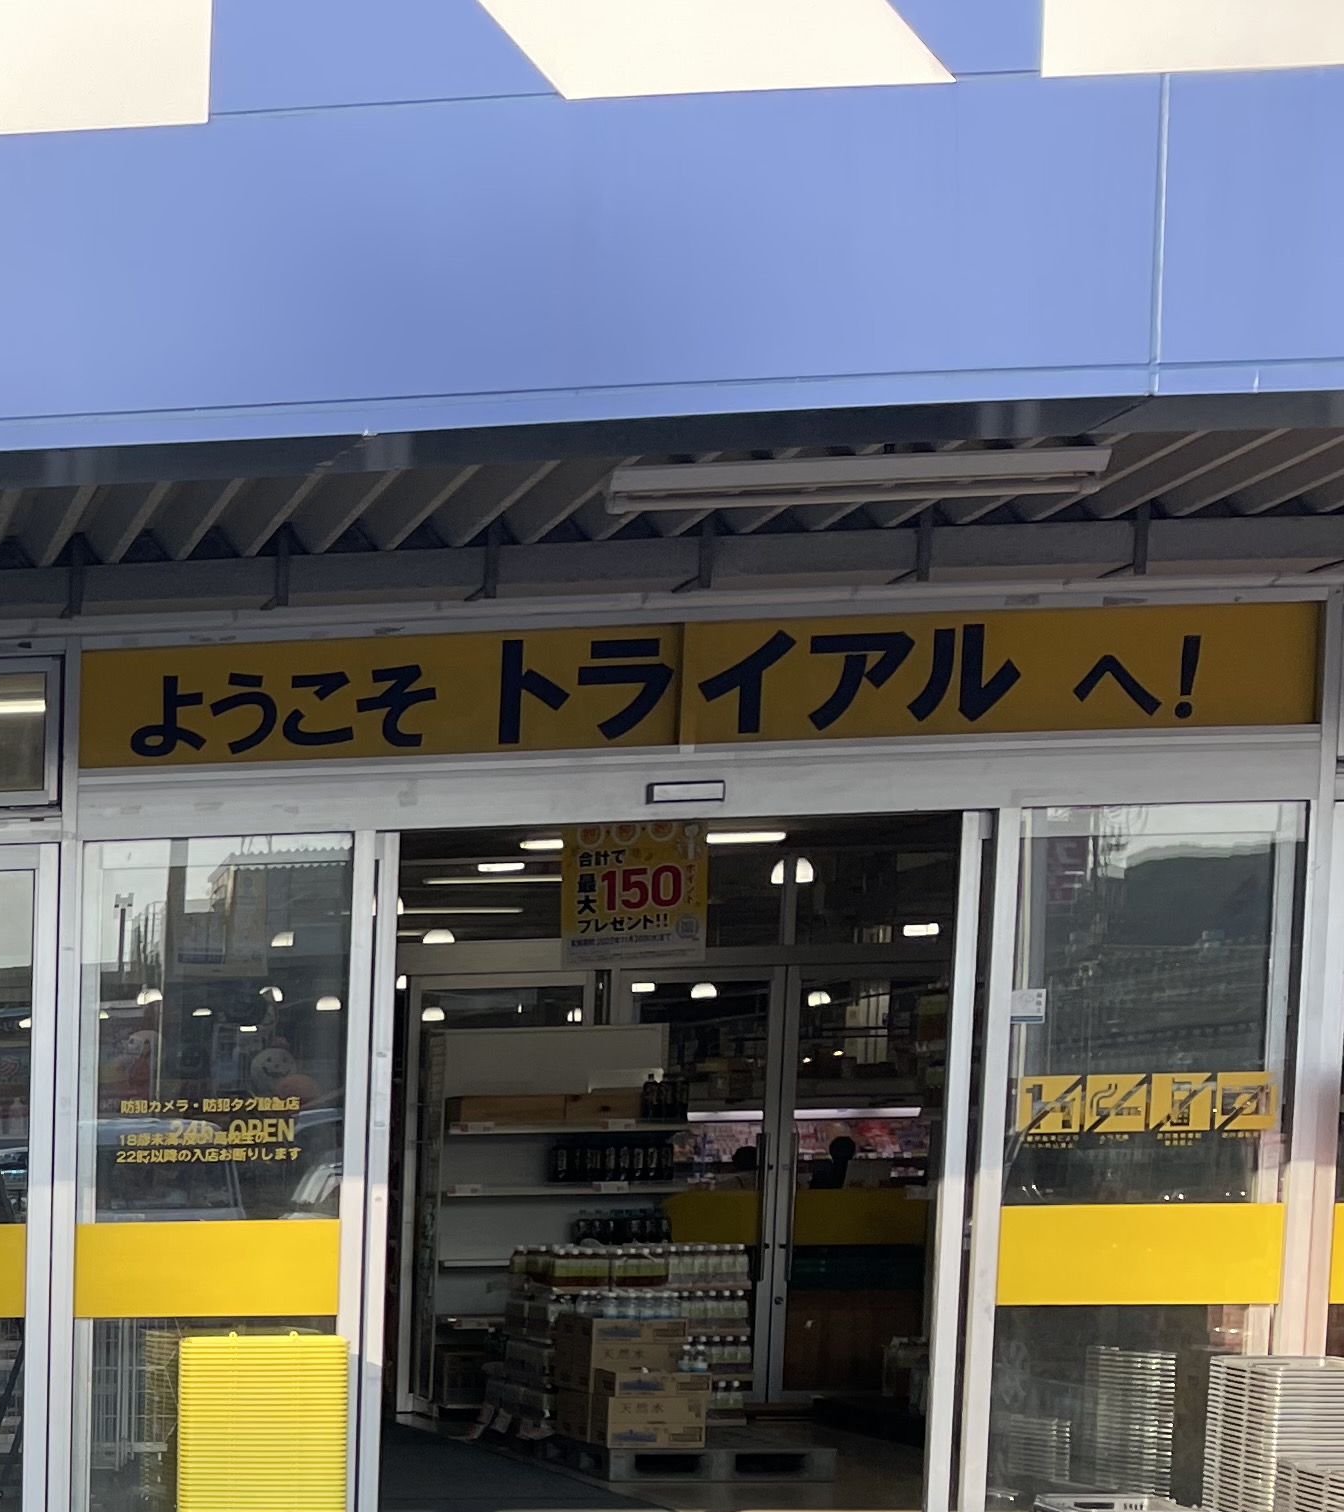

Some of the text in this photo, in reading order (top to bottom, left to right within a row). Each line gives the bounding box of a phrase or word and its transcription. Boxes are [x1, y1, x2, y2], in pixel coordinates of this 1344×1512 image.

[130, 664, 437, 757] ようこそ
[498, 623, 1020, 743] トライアル
[579, 849, 626, 867] 合計で
[577, 873, 597, 915] 最大
[601, 865, 683, 911] 150
[228, 1117, 295, 1142] OPEN
[116, 1147, 302, 1165] 22時以降の入店お断りします
[619, 1401, 664, 1414] 天然水
